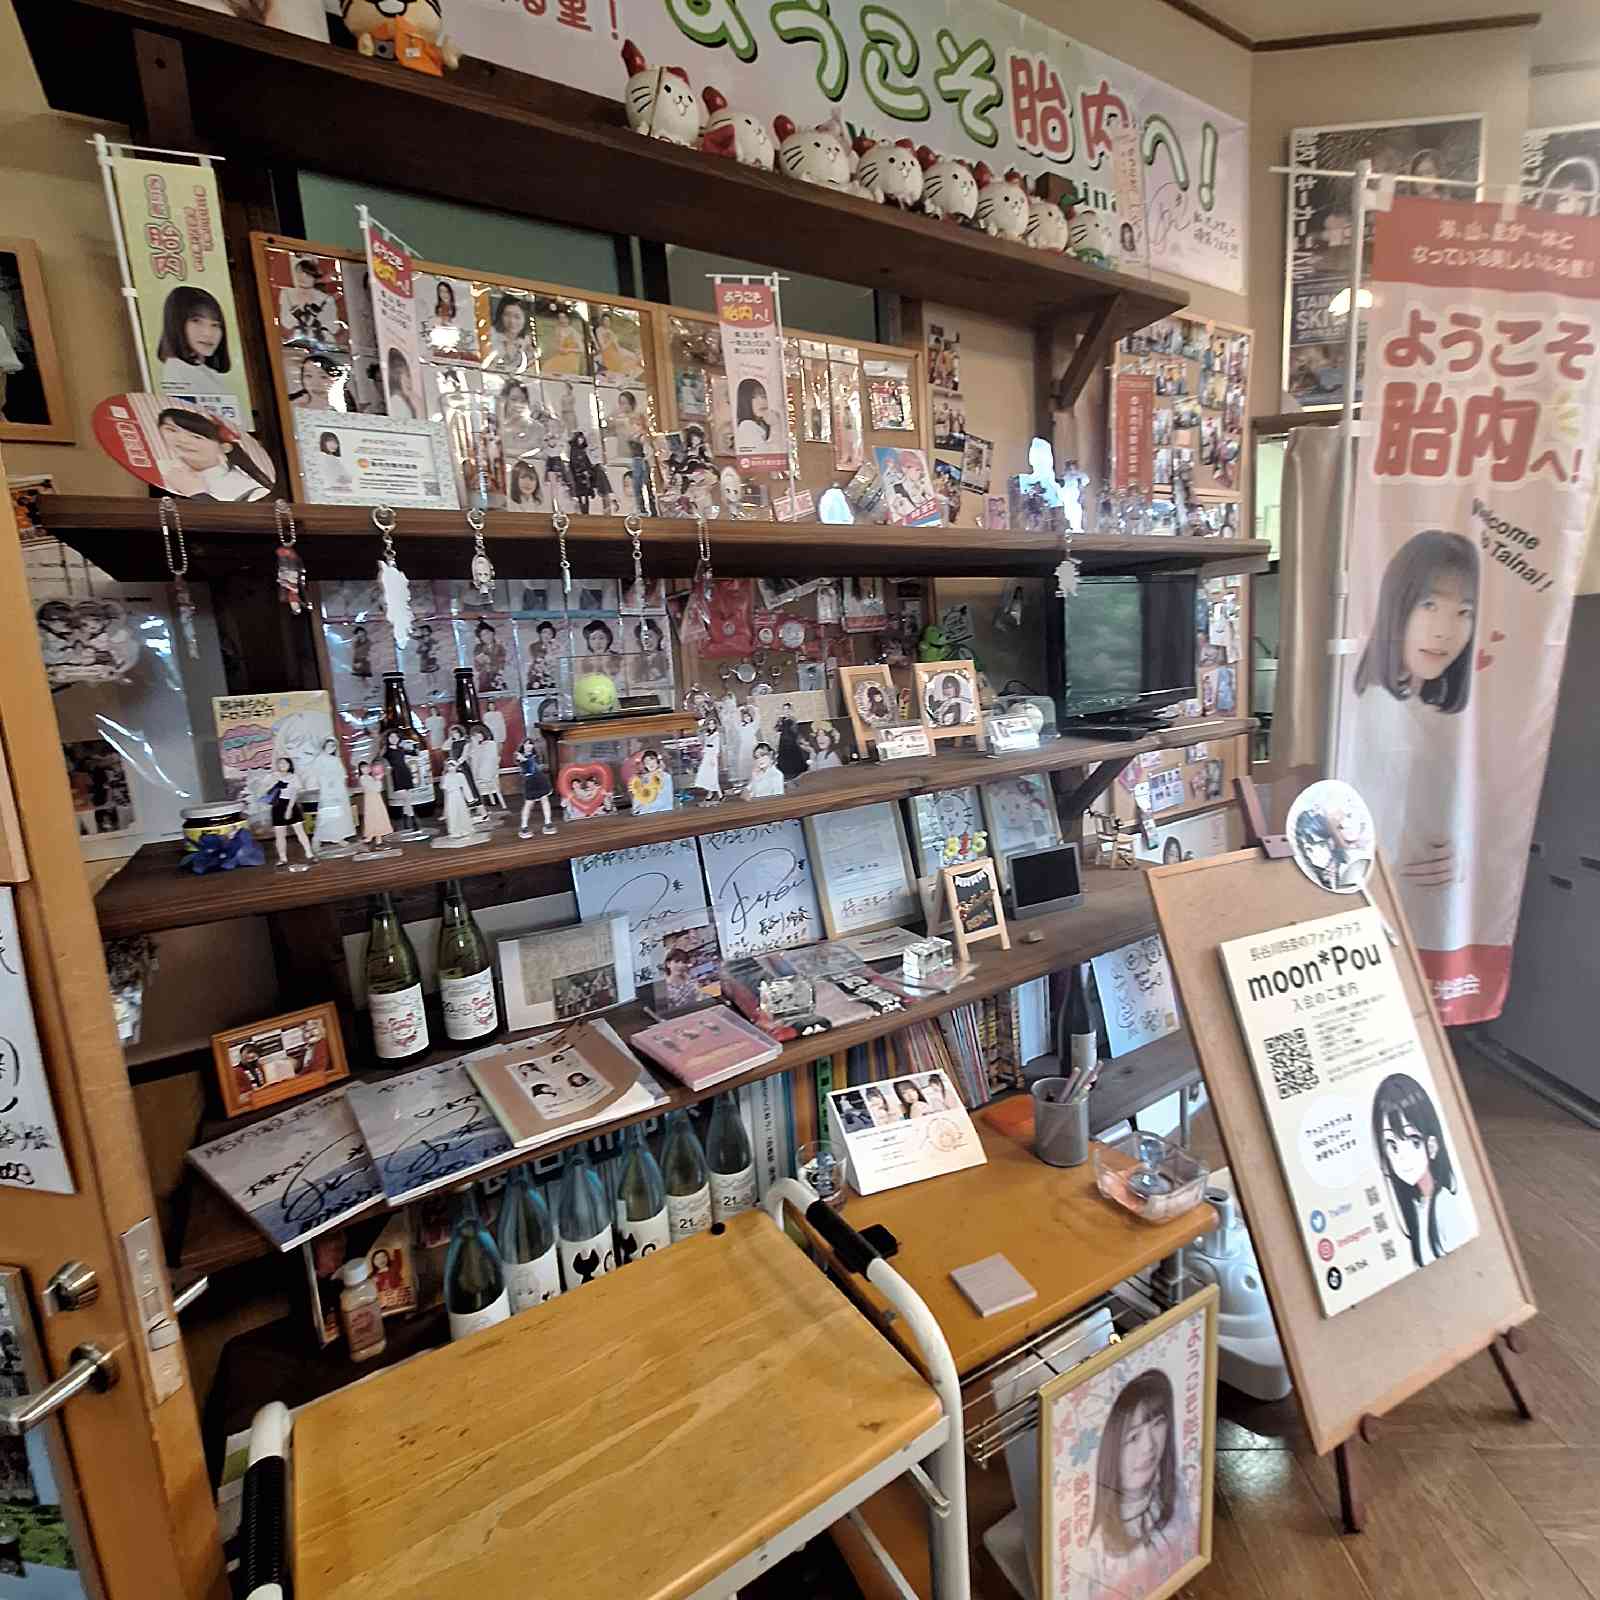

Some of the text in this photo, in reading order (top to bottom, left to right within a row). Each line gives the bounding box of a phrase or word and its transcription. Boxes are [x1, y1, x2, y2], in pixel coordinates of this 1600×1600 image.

[1384, 309, 1595, 381] ようこそ
[1373, 381, 1582, 483] 胎内へ!
[1291, 981, 1360, 1014] 入会のご案内
